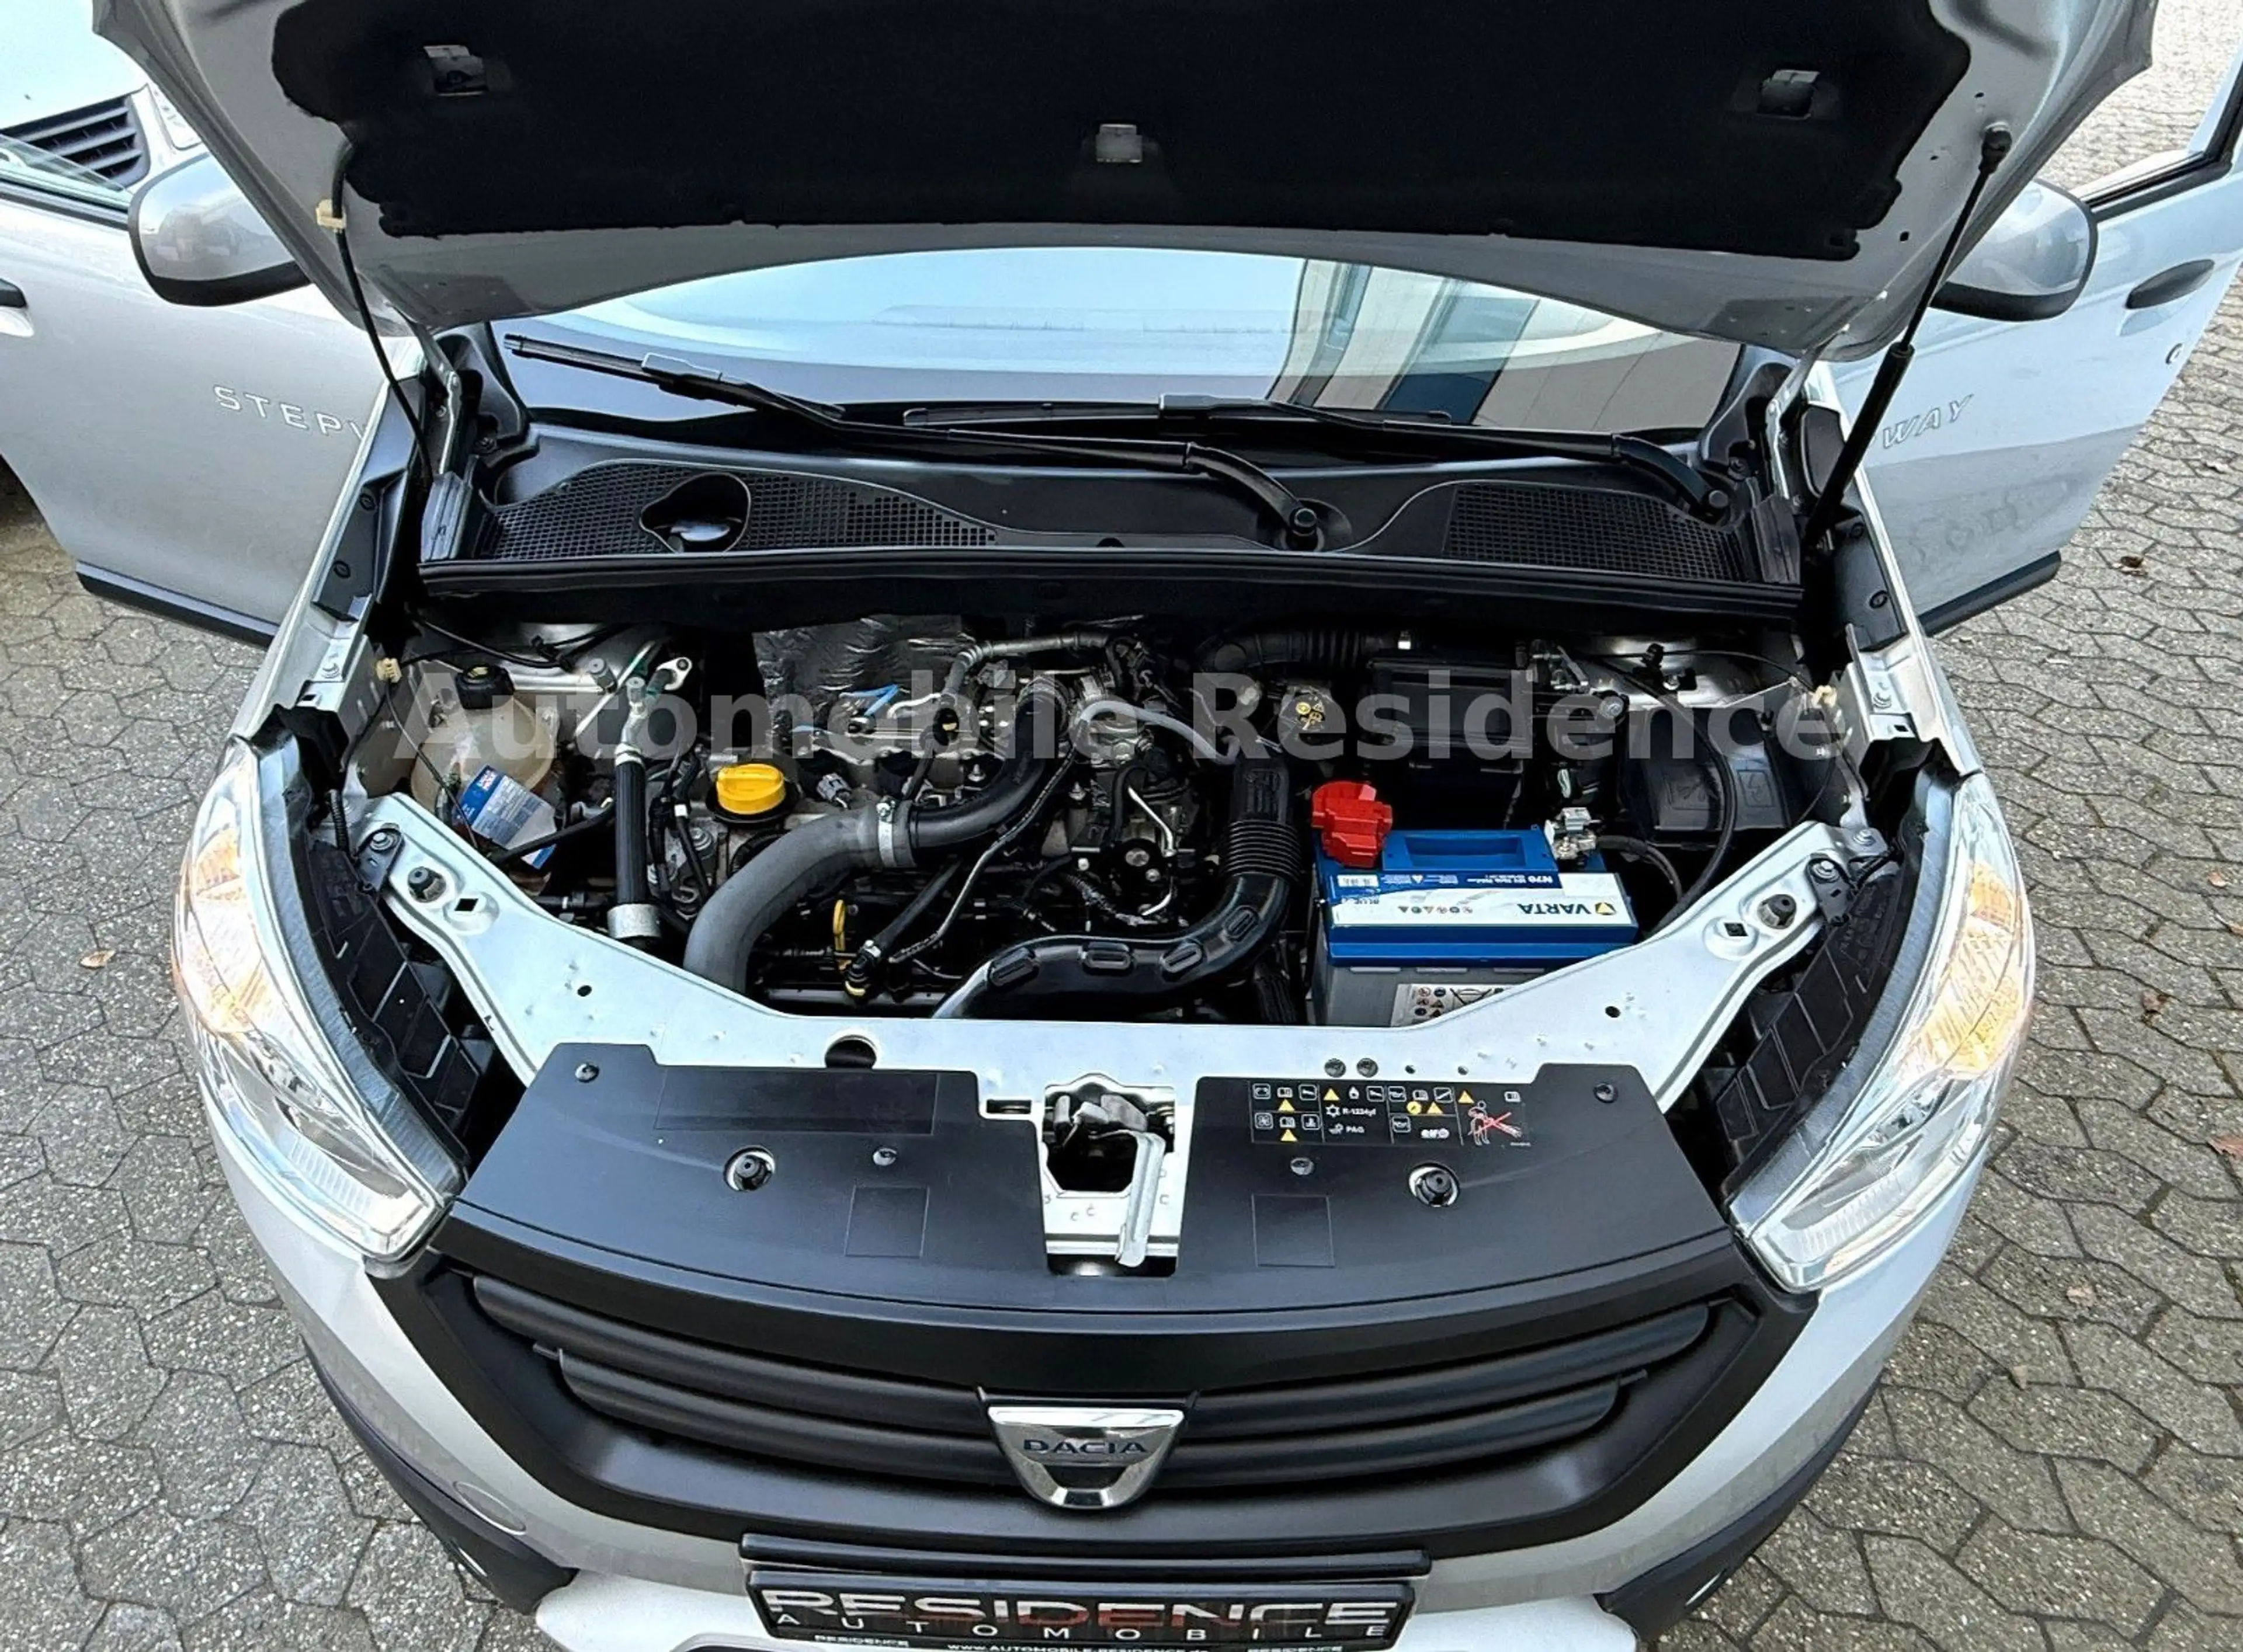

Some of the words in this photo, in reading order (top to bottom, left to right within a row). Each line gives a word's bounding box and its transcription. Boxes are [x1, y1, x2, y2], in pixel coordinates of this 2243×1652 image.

[1883, 394, 1974, 449] WAY
[1517, 903, 1592, 914] VARTA
[1023, 1439, 1146, 1454] DACIA
[761, 1590, 1397, 1626] RESIDENCE
[777, 1613, 1387, 1640] AUTOMOBILE
